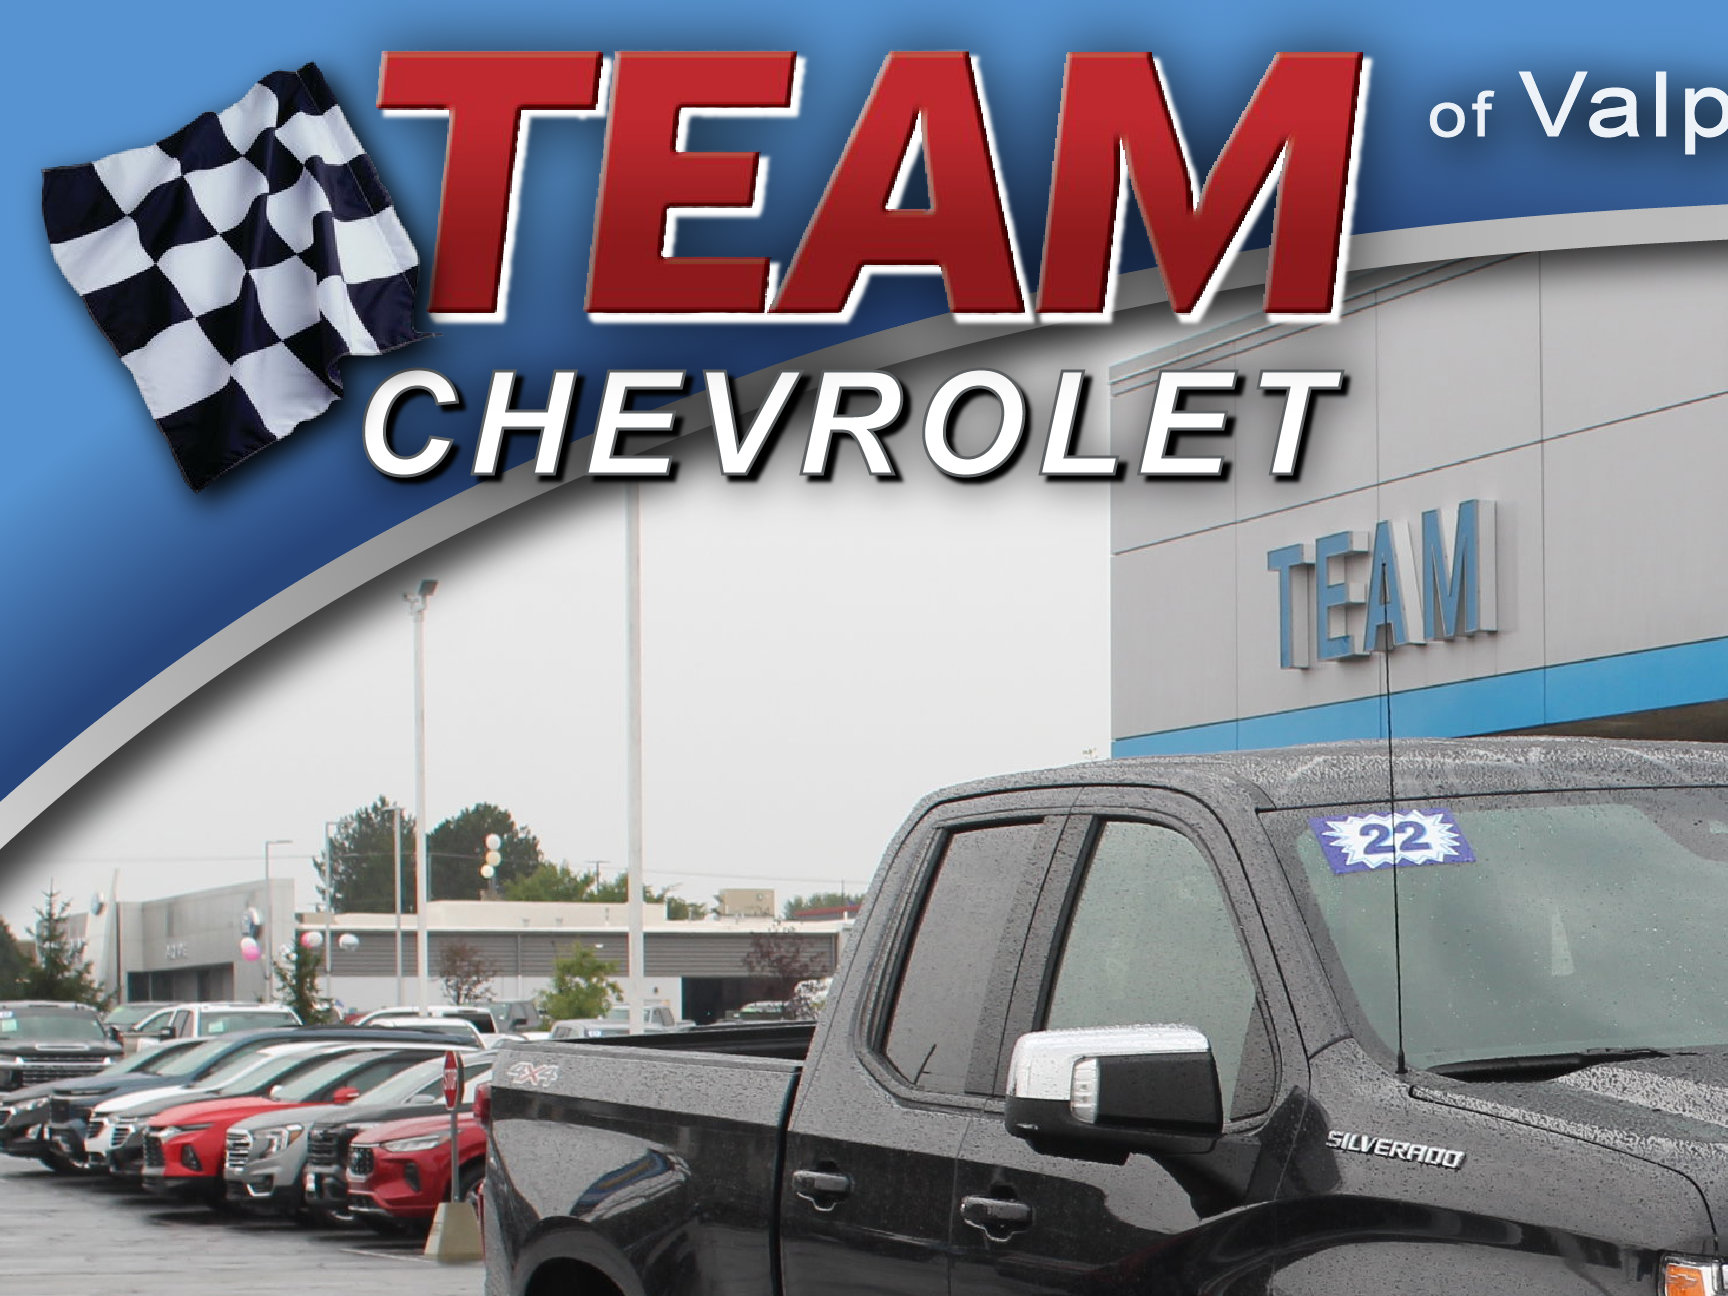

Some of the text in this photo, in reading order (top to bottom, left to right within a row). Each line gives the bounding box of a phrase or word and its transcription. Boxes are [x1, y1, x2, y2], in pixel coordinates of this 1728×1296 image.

[1267, 499, 1497, 670] TEAM
[1359, 820, 1432, 855] 22
[1325, 1129, 1467, 1171] SILVERADO
